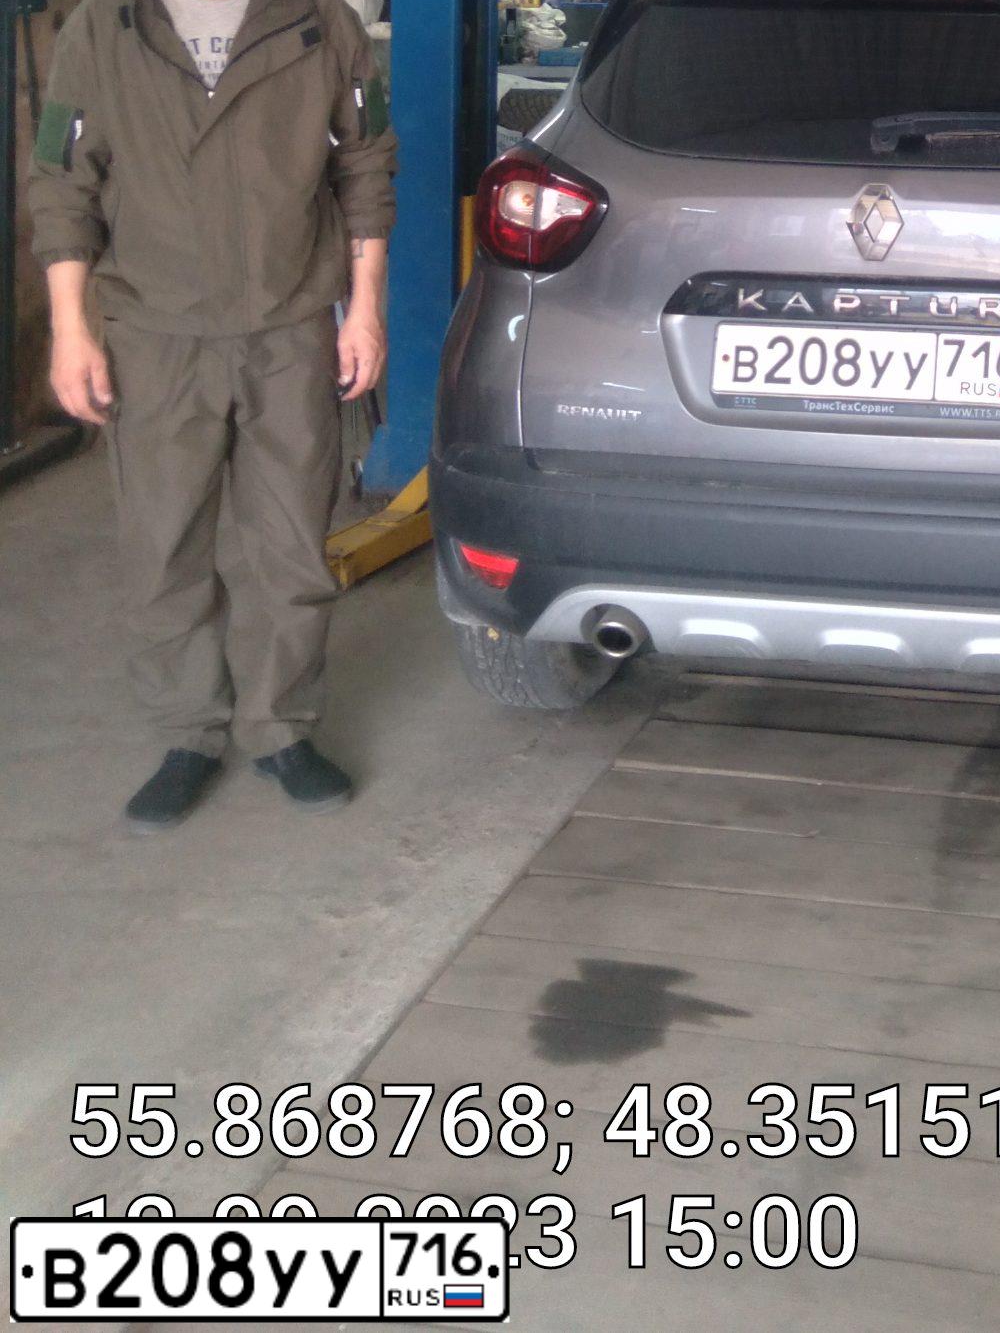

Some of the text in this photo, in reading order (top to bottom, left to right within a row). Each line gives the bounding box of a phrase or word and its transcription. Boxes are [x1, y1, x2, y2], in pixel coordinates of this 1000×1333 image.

[960, 381, 997, 397] RUS
[557, 404, 642, 421] RENAULT
[802, 399, 896, 414] ТрансТехСервис
